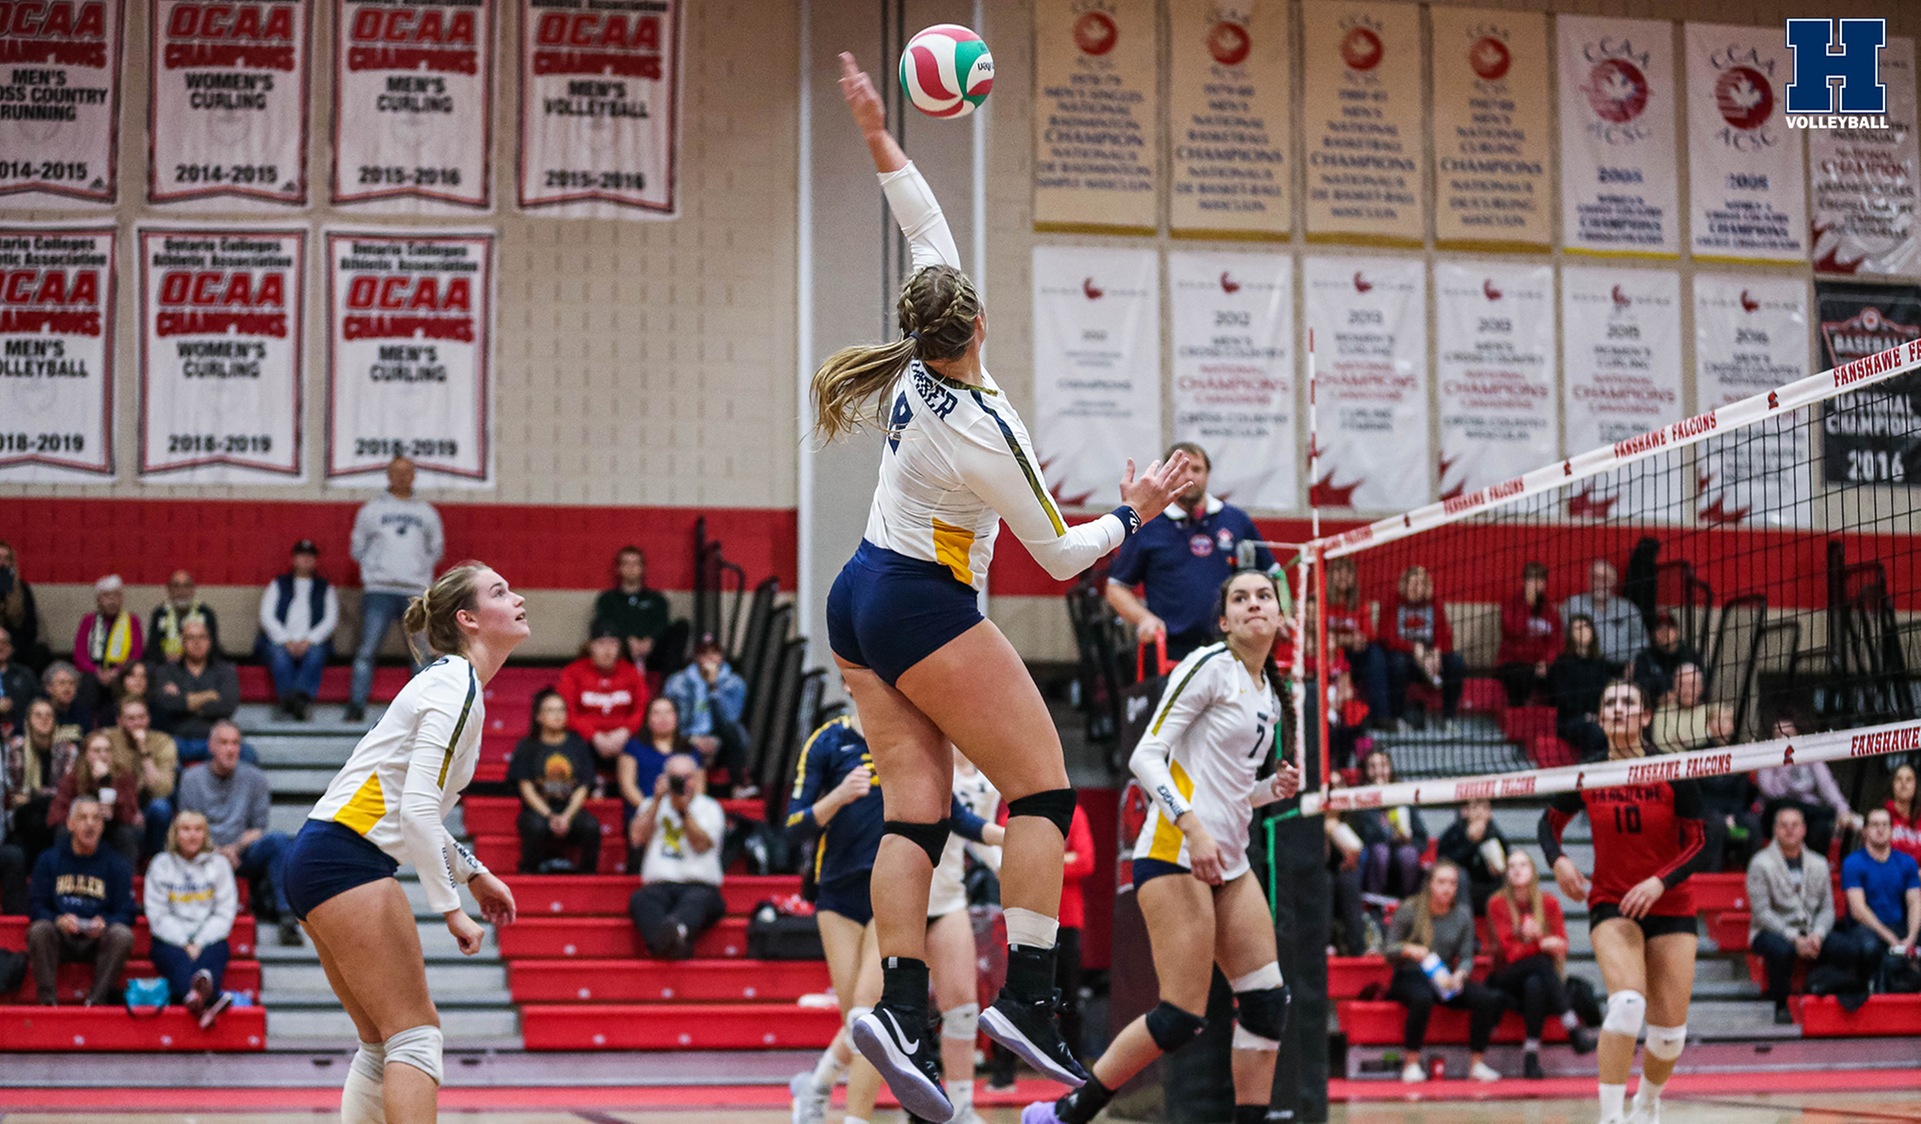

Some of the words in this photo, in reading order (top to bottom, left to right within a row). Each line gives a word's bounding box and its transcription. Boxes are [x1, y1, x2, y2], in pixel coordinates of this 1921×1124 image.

[166, 4, 294, 39] OCAA
[351, 8, 477, 42] OCAA
[536, 11, 661, 48] OCAA
[12, 69, 67, 86] MEN'S
[185, 71, 274, 91] WOMEN'S
[386, 76, 446, 93] MEN'S
[0, 86, 27, 102] OSS
[31, 87, 108, 104] COUNTRY
[568, 79, 626, 98] MEN'S
[190, 92, 267, 110] CURLING
[376, 95, 454, 113] CURLING
[544, 99, 650, 119] VOLLEYBALL
[1, 104, 76, 121] RUNNING
[175, 164, 278, 183] 2014-2015
[358, 166, 461, 185] 2015-2016
[0, 269, 98, 306] CAA
[158, 270, 286, 307] OCAA
[346, 274, 472, 311] OCAA
[5, 340, 65, 357] MEN'S
[177, 340, 267, 358] WOMEN'S
[378, 345, 438, 362] MEN'S
[0, 360, 88, 378] LLEYBALL
[182, 360, 261, 378] CURLING
[370, 364, 447, 382] CURLING
[1833, 347, 1902, 388] FANSHAWE
[1571, 385, 1677, 404] CHAMPIONS
[1614, 428, 1667, 459] FANSHAWE
[1672, 411, 1717, 442] FALCONS
[1248, 723, 1265, 759] 7
[1851, 726, 1920, 757] FANSHAWE
[1628, 760, 1681, 784] FANSHAWE
[1685, 753, 1732, 778] FALCONS
[1614, 804, 1642, 834] 10
